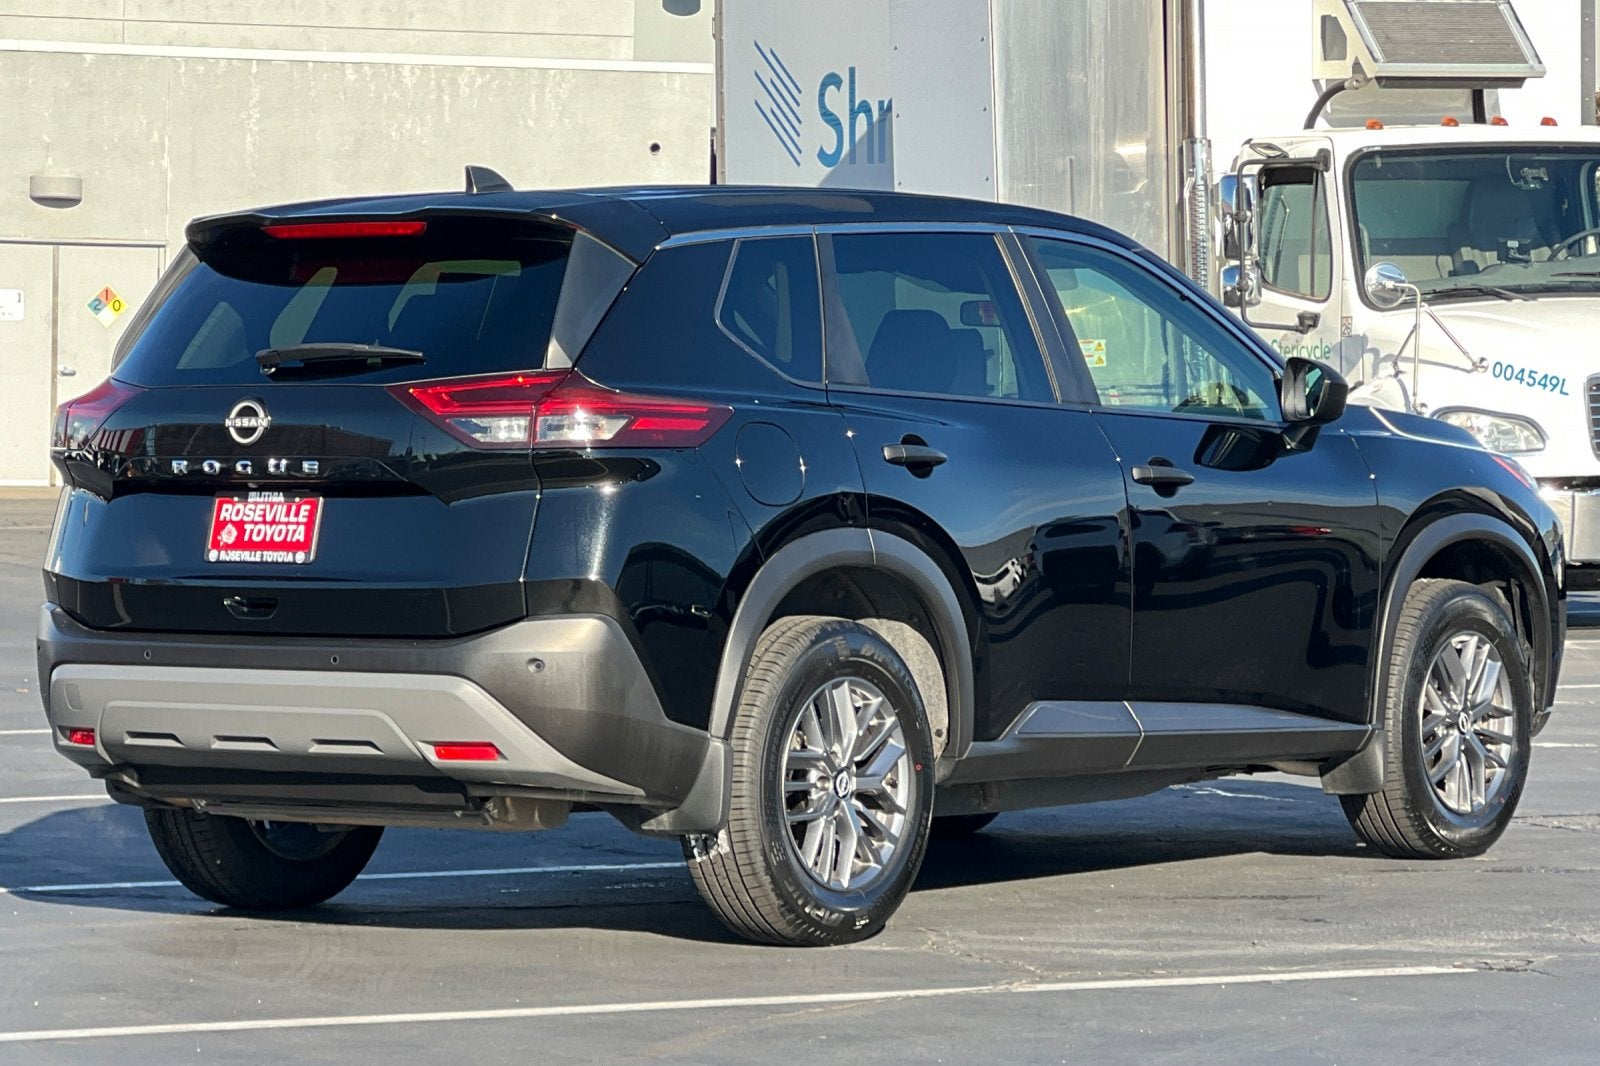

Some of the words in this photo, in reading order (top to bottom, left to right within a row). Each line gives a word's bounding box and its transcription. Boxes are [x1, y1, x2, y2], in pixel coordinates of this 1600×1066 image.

[93, 298, 102, 311] 2
[1492, 361, 1569, 396] 004549L
[225, 416, 269, 428] NISSAN
[171, 458, 320, 475] ROGUE
[219, 503, 311, 523] ROSEVILLE
[243, 523, 305, 542] TOYOTA
